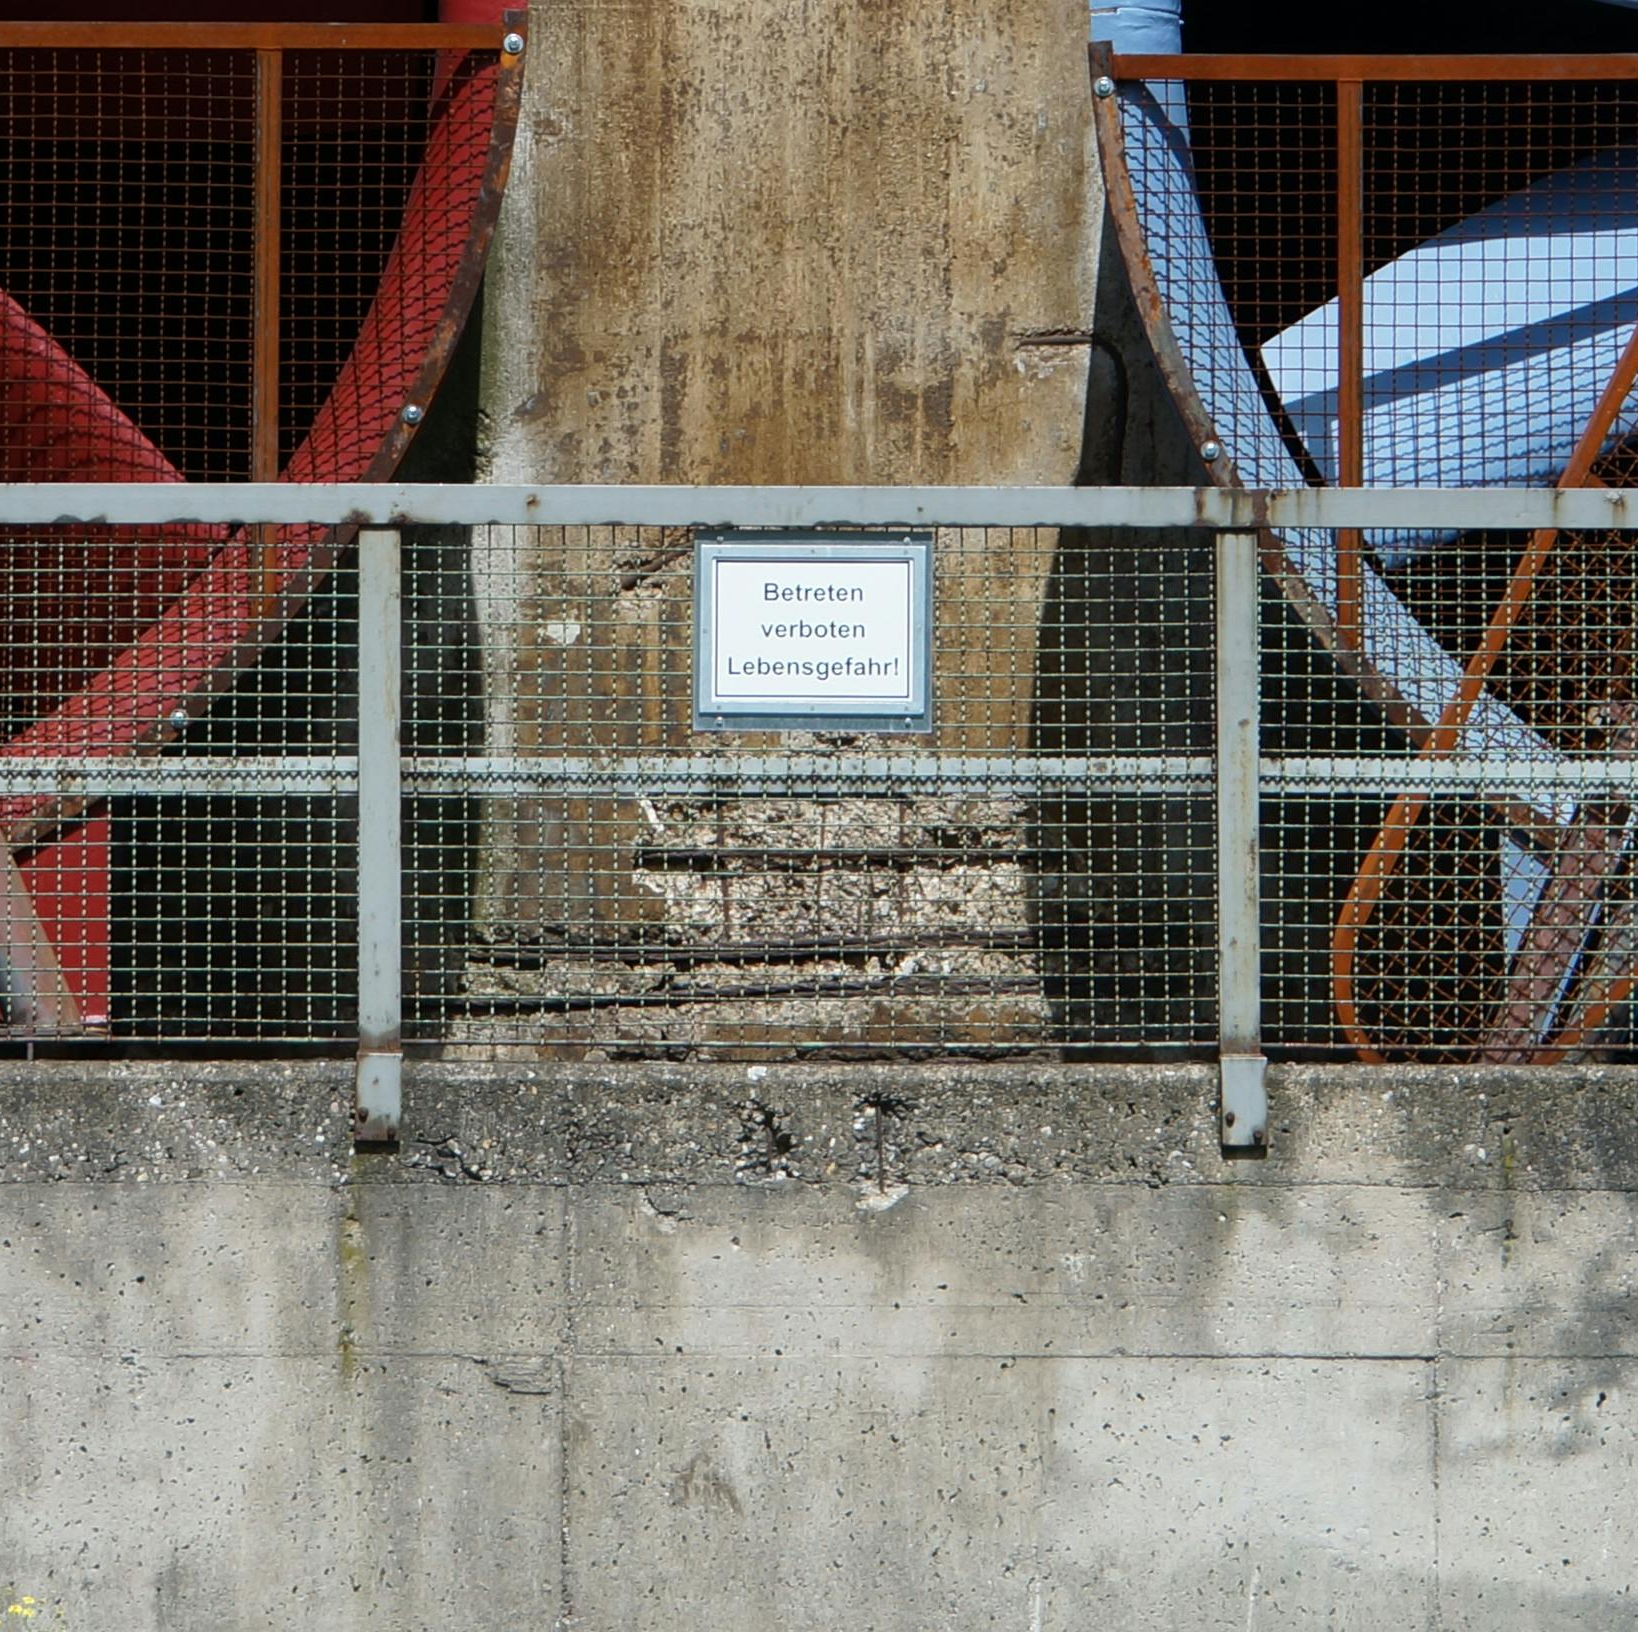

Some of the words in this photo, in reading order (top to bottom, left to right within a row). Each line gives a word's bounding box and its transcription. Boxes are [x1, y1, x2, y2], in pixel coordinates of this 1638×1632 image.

[764, 582, 863, 601] Betreten
[761, 619, 865, 638] verboten
[728, 657, 899, 680] Lebensgefahr!
